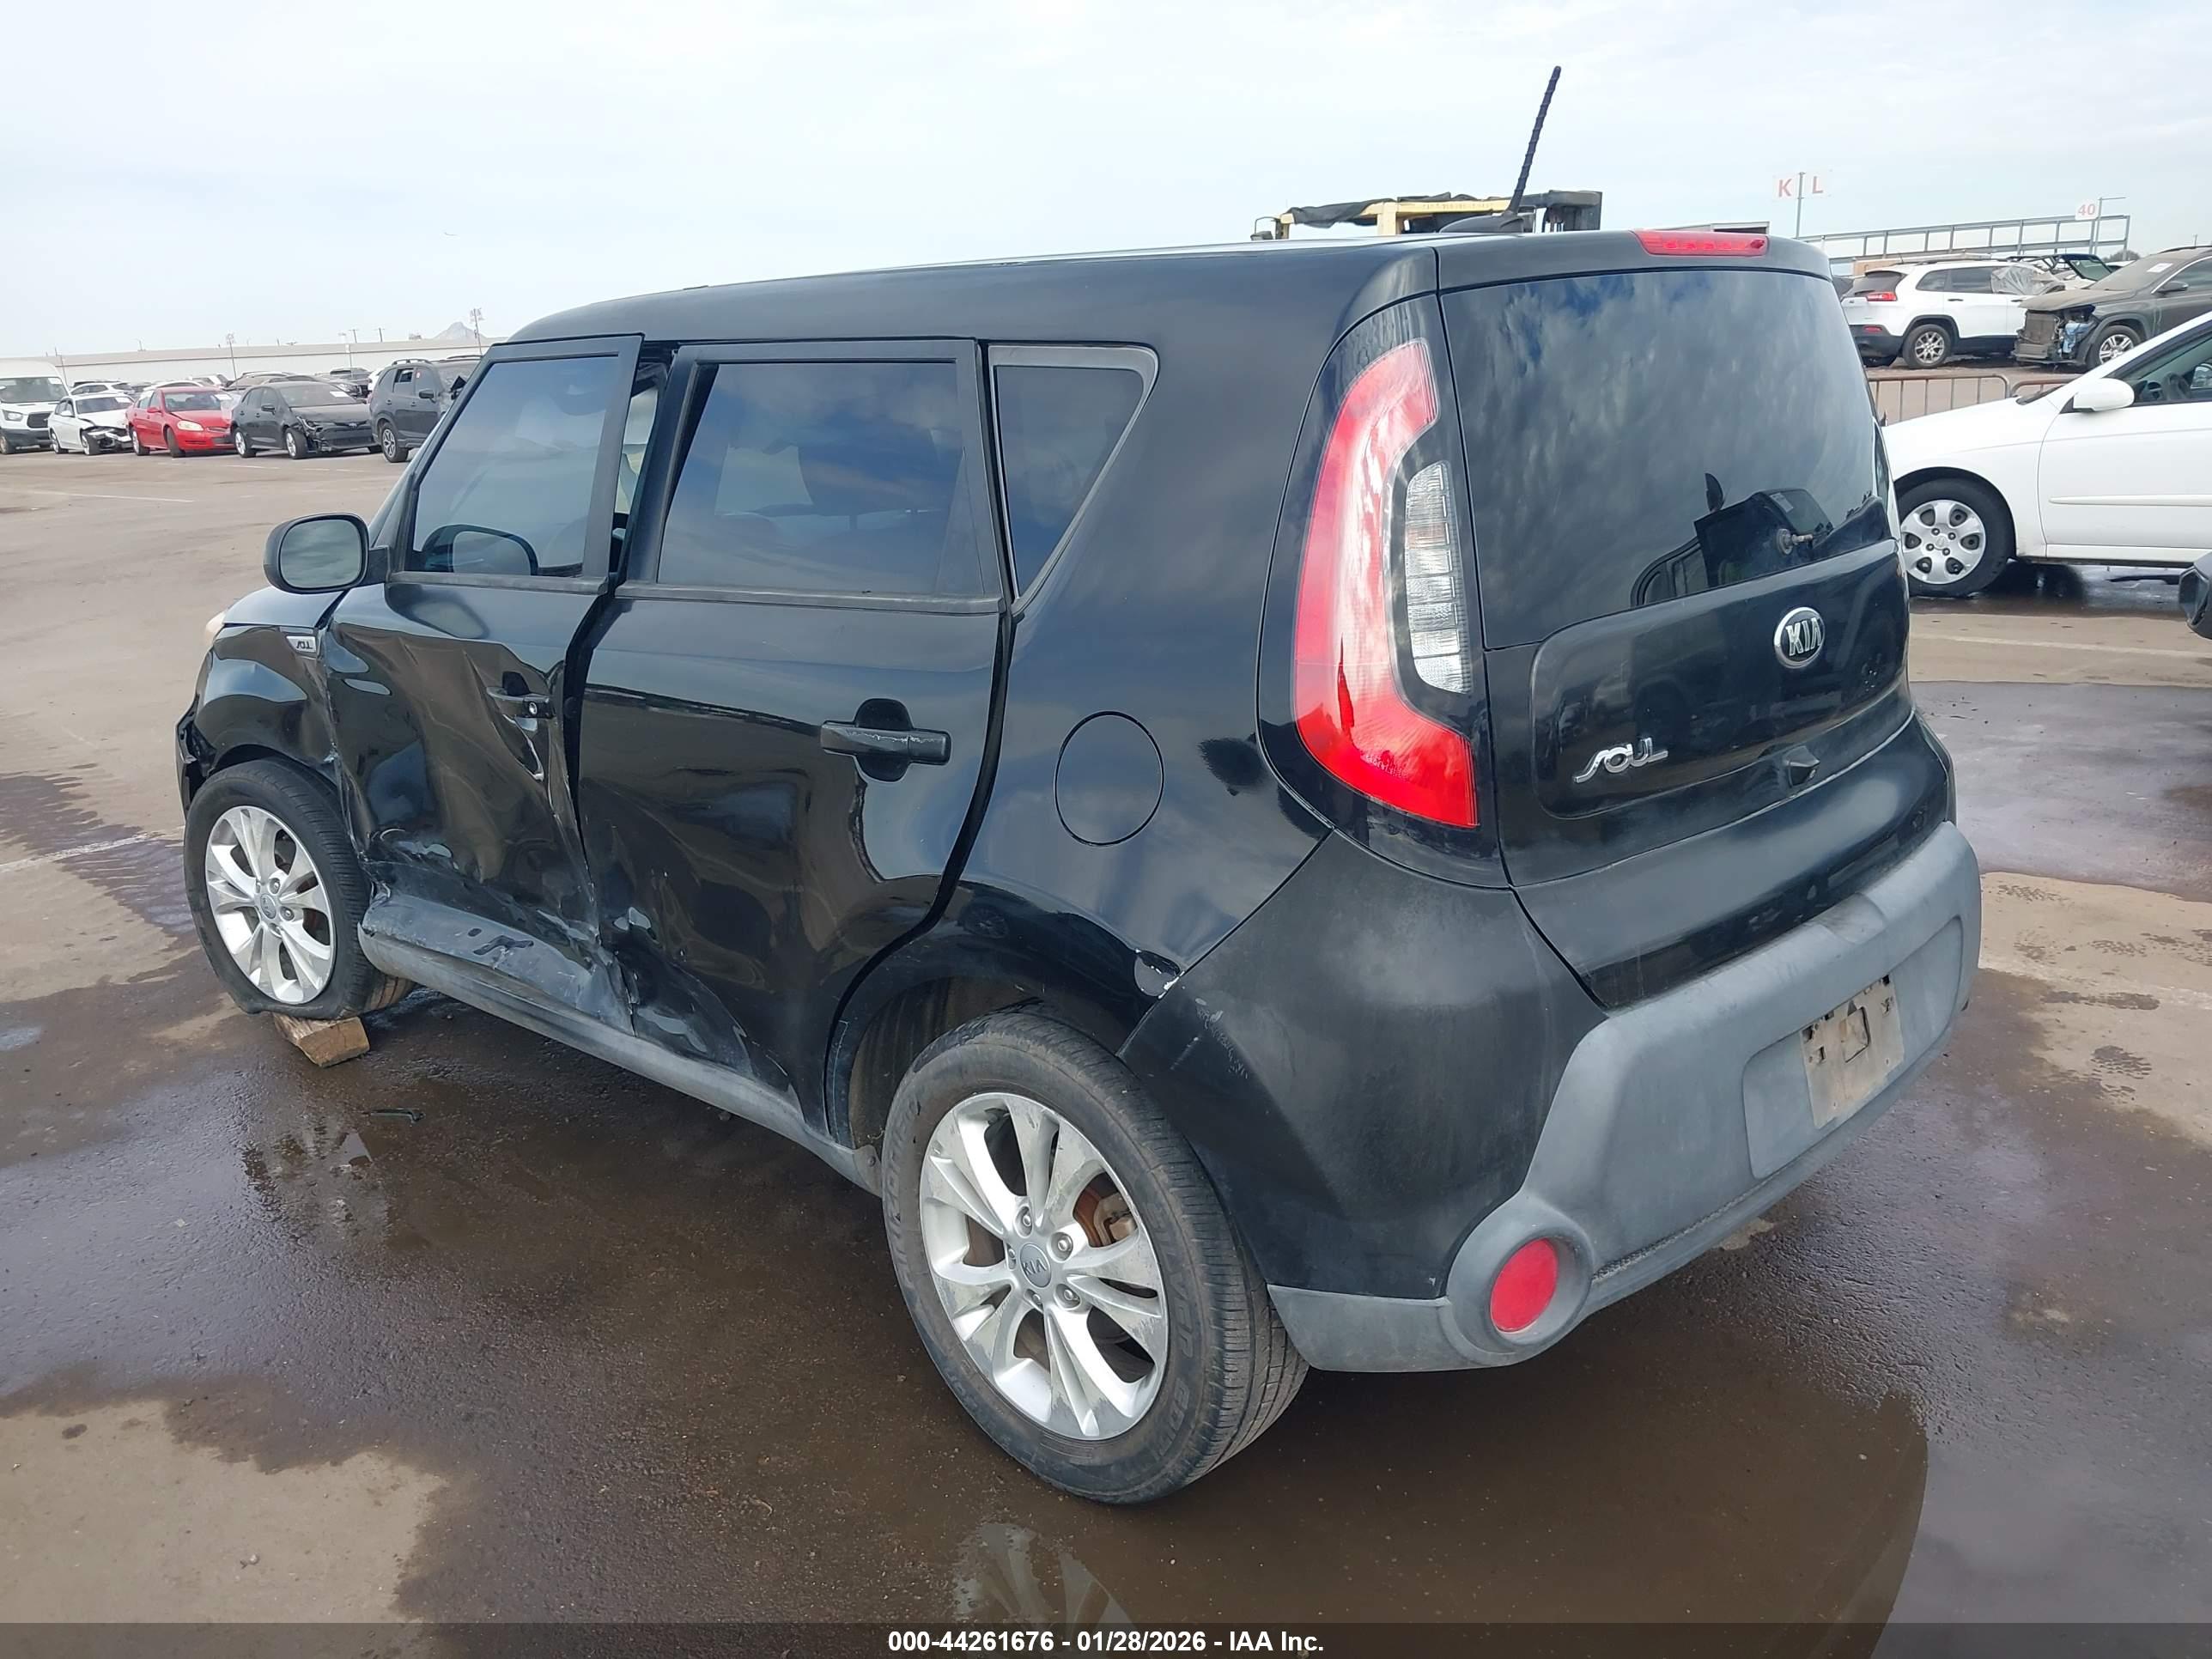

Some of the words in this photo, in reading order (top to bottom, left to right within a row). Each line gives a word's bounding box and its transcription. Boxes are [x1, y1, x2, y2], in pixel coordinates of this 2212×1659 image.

[1778, 178, 1793, 198] K
[1812, 175, 1824, 194] L
[2078, 203, 2096, 216] 40
[1785, 617, 1822, 657] KIA
[1573, 737, 1669, 783] SOUL
[1022, 1257, 1048, 1277] KIA
